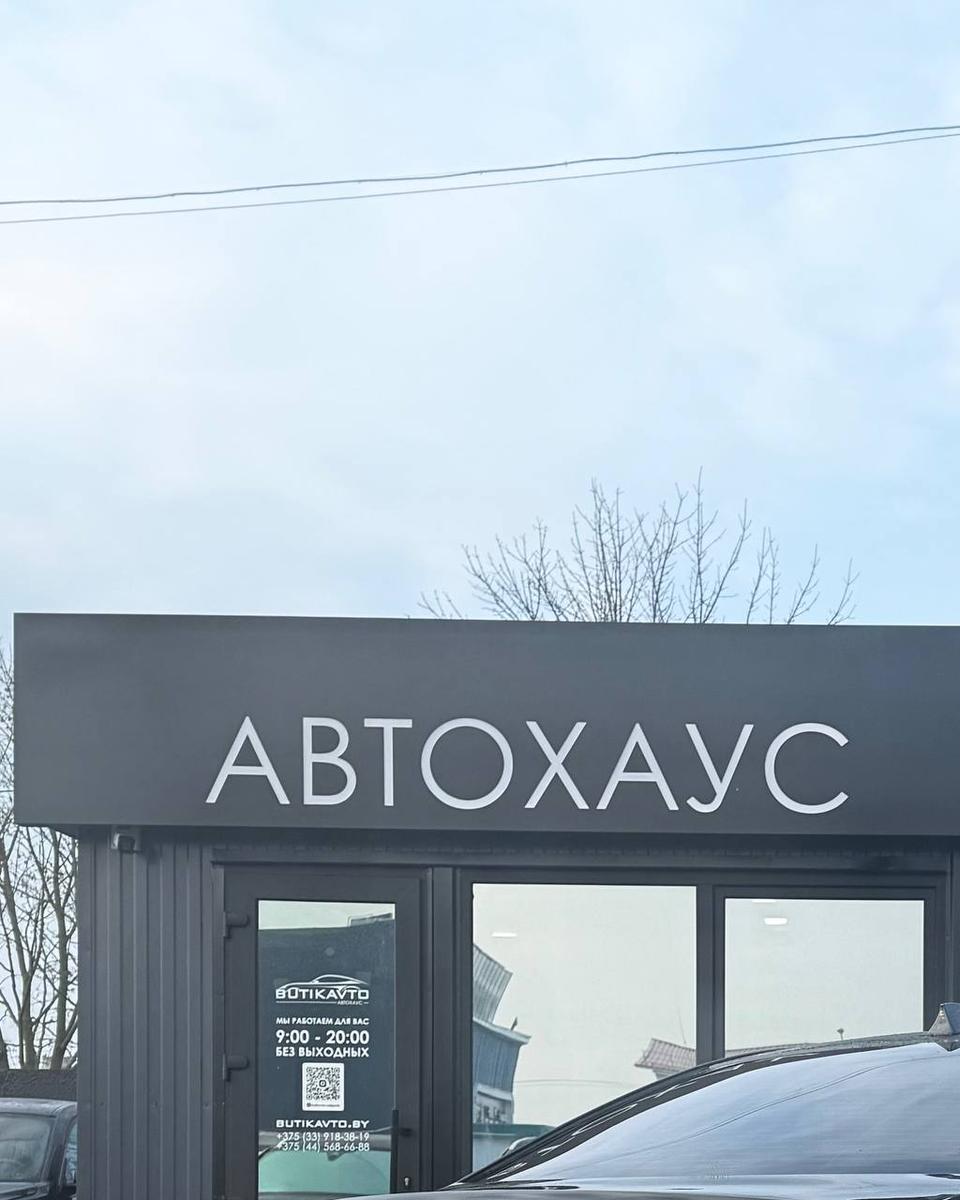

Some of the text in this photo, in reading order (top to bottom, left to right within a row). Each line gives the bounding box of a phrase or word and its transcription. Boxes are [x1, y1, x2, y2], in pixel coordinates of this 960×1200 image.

[205, 715, 849, 814] АВТОХАУС
[275, 988, 369, 999] BUTIKAVTO
[275, 1017, 370, 1026] МЫ РАБОТАЕМ ДЛЯ ВАС
[275, 1029, 310, 1044] 9:00
[325, 1029, 370, 1044] 20:00
[275, 1046, 370, 1059] БЕЗ ВЫХОДНЫХ
[275, 1119, 370, 1129] BUTIKAVTO.BY
[276, 1132, 370, 1142] +375 (33) 918-38-19
[302, 1142, 321, 1153] (44)
[323, 1142, 370, 1152] 568-66-88
